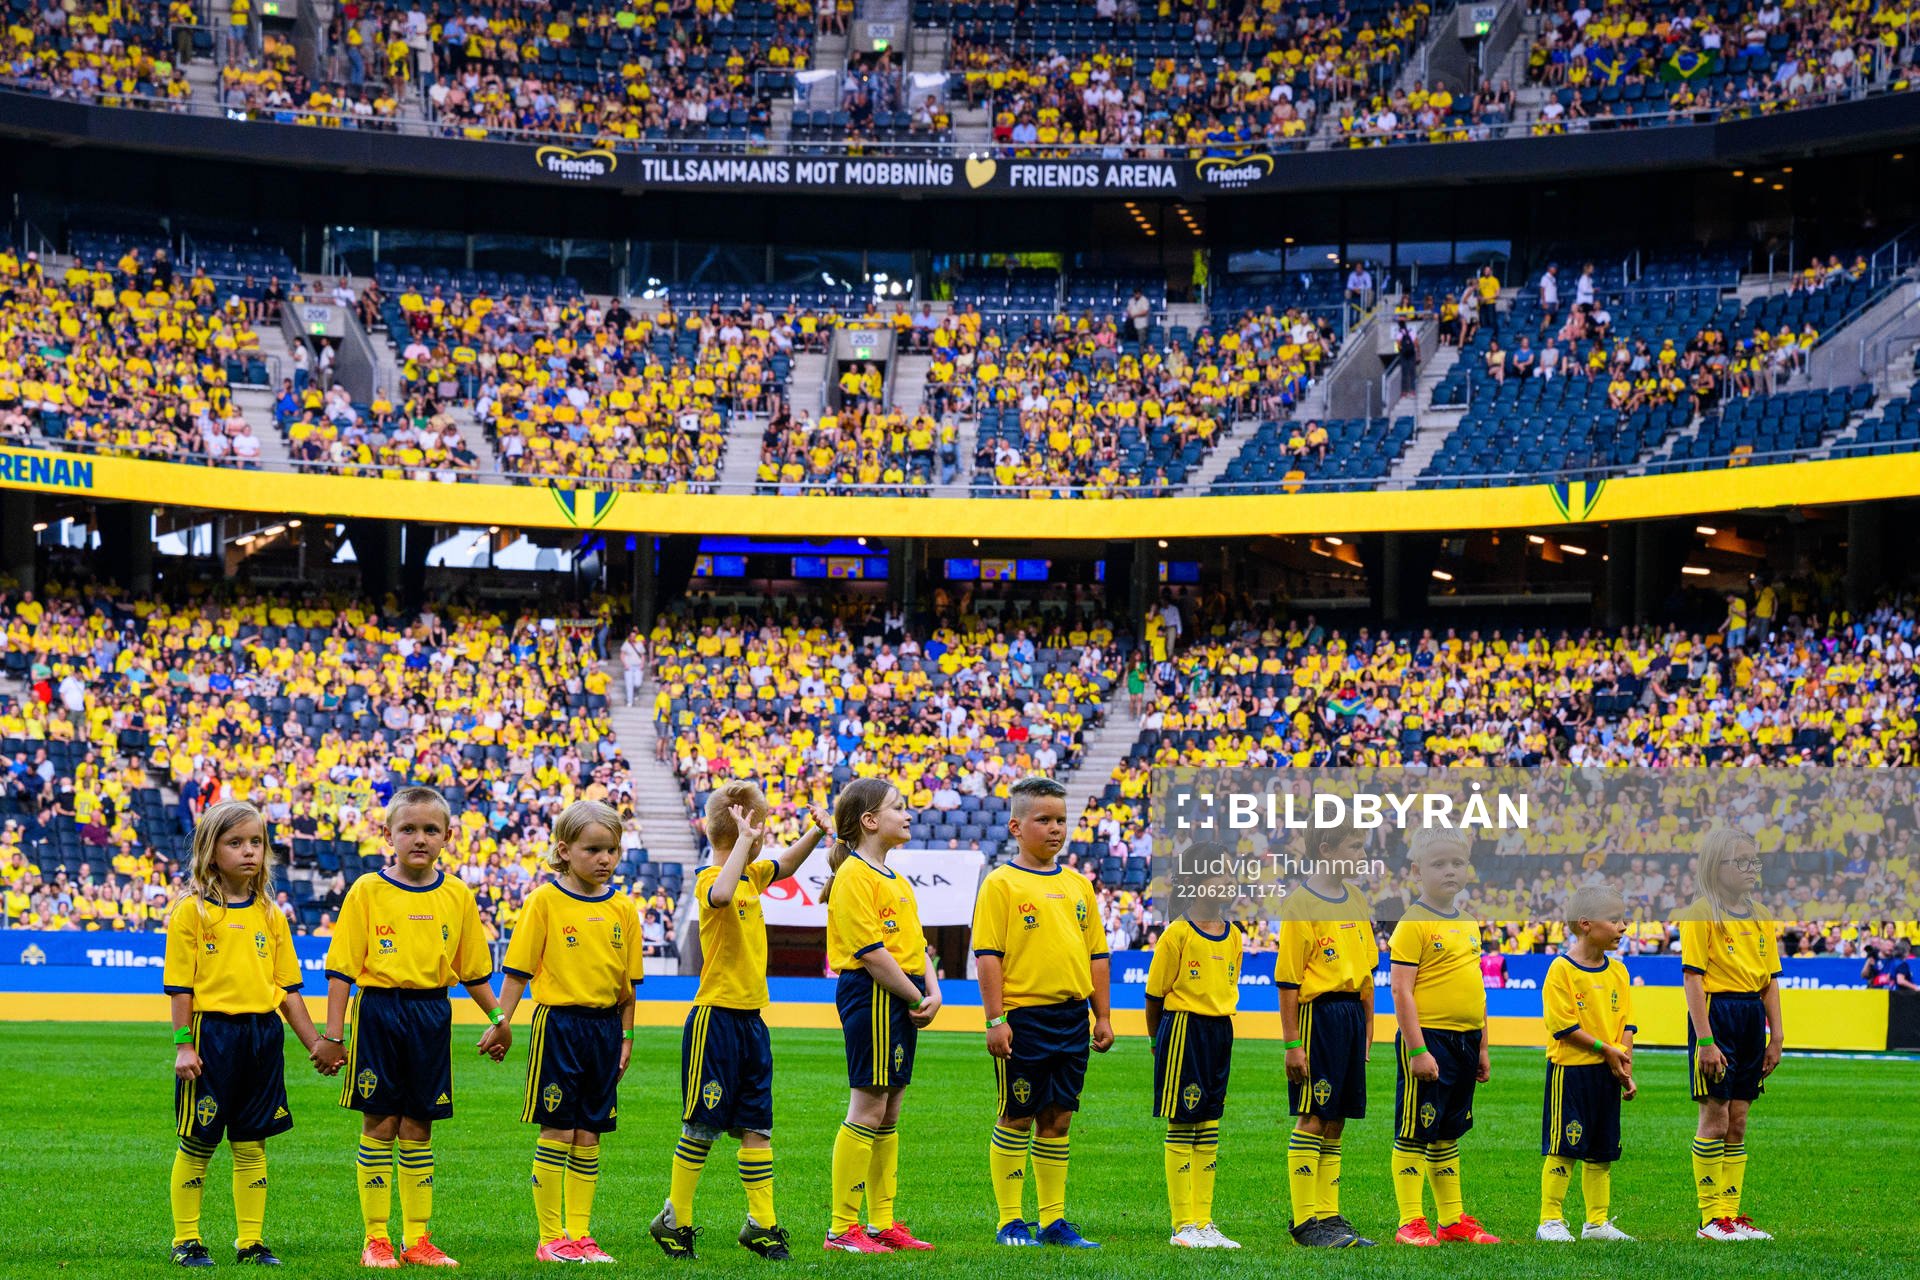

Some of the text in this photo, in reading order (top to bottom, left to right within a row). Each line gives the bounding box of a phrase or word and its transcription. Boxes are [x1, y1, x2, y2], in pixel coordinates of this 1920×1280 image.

[547, 154, 605, 175] friends
[642, 159, 1177, 187] TILLSAMMANS MOT MOBBNING FRIENDS ARENA
[1206, 163, 1262, 183] friends
[878, 907, 896, 919] ICA
[1018, 903, 1038, 914] ICA
[375, 925, 396, 936] ICA
[562, 926, 578, 935] ICA
[1188, 960, 1201, 968] ICA
